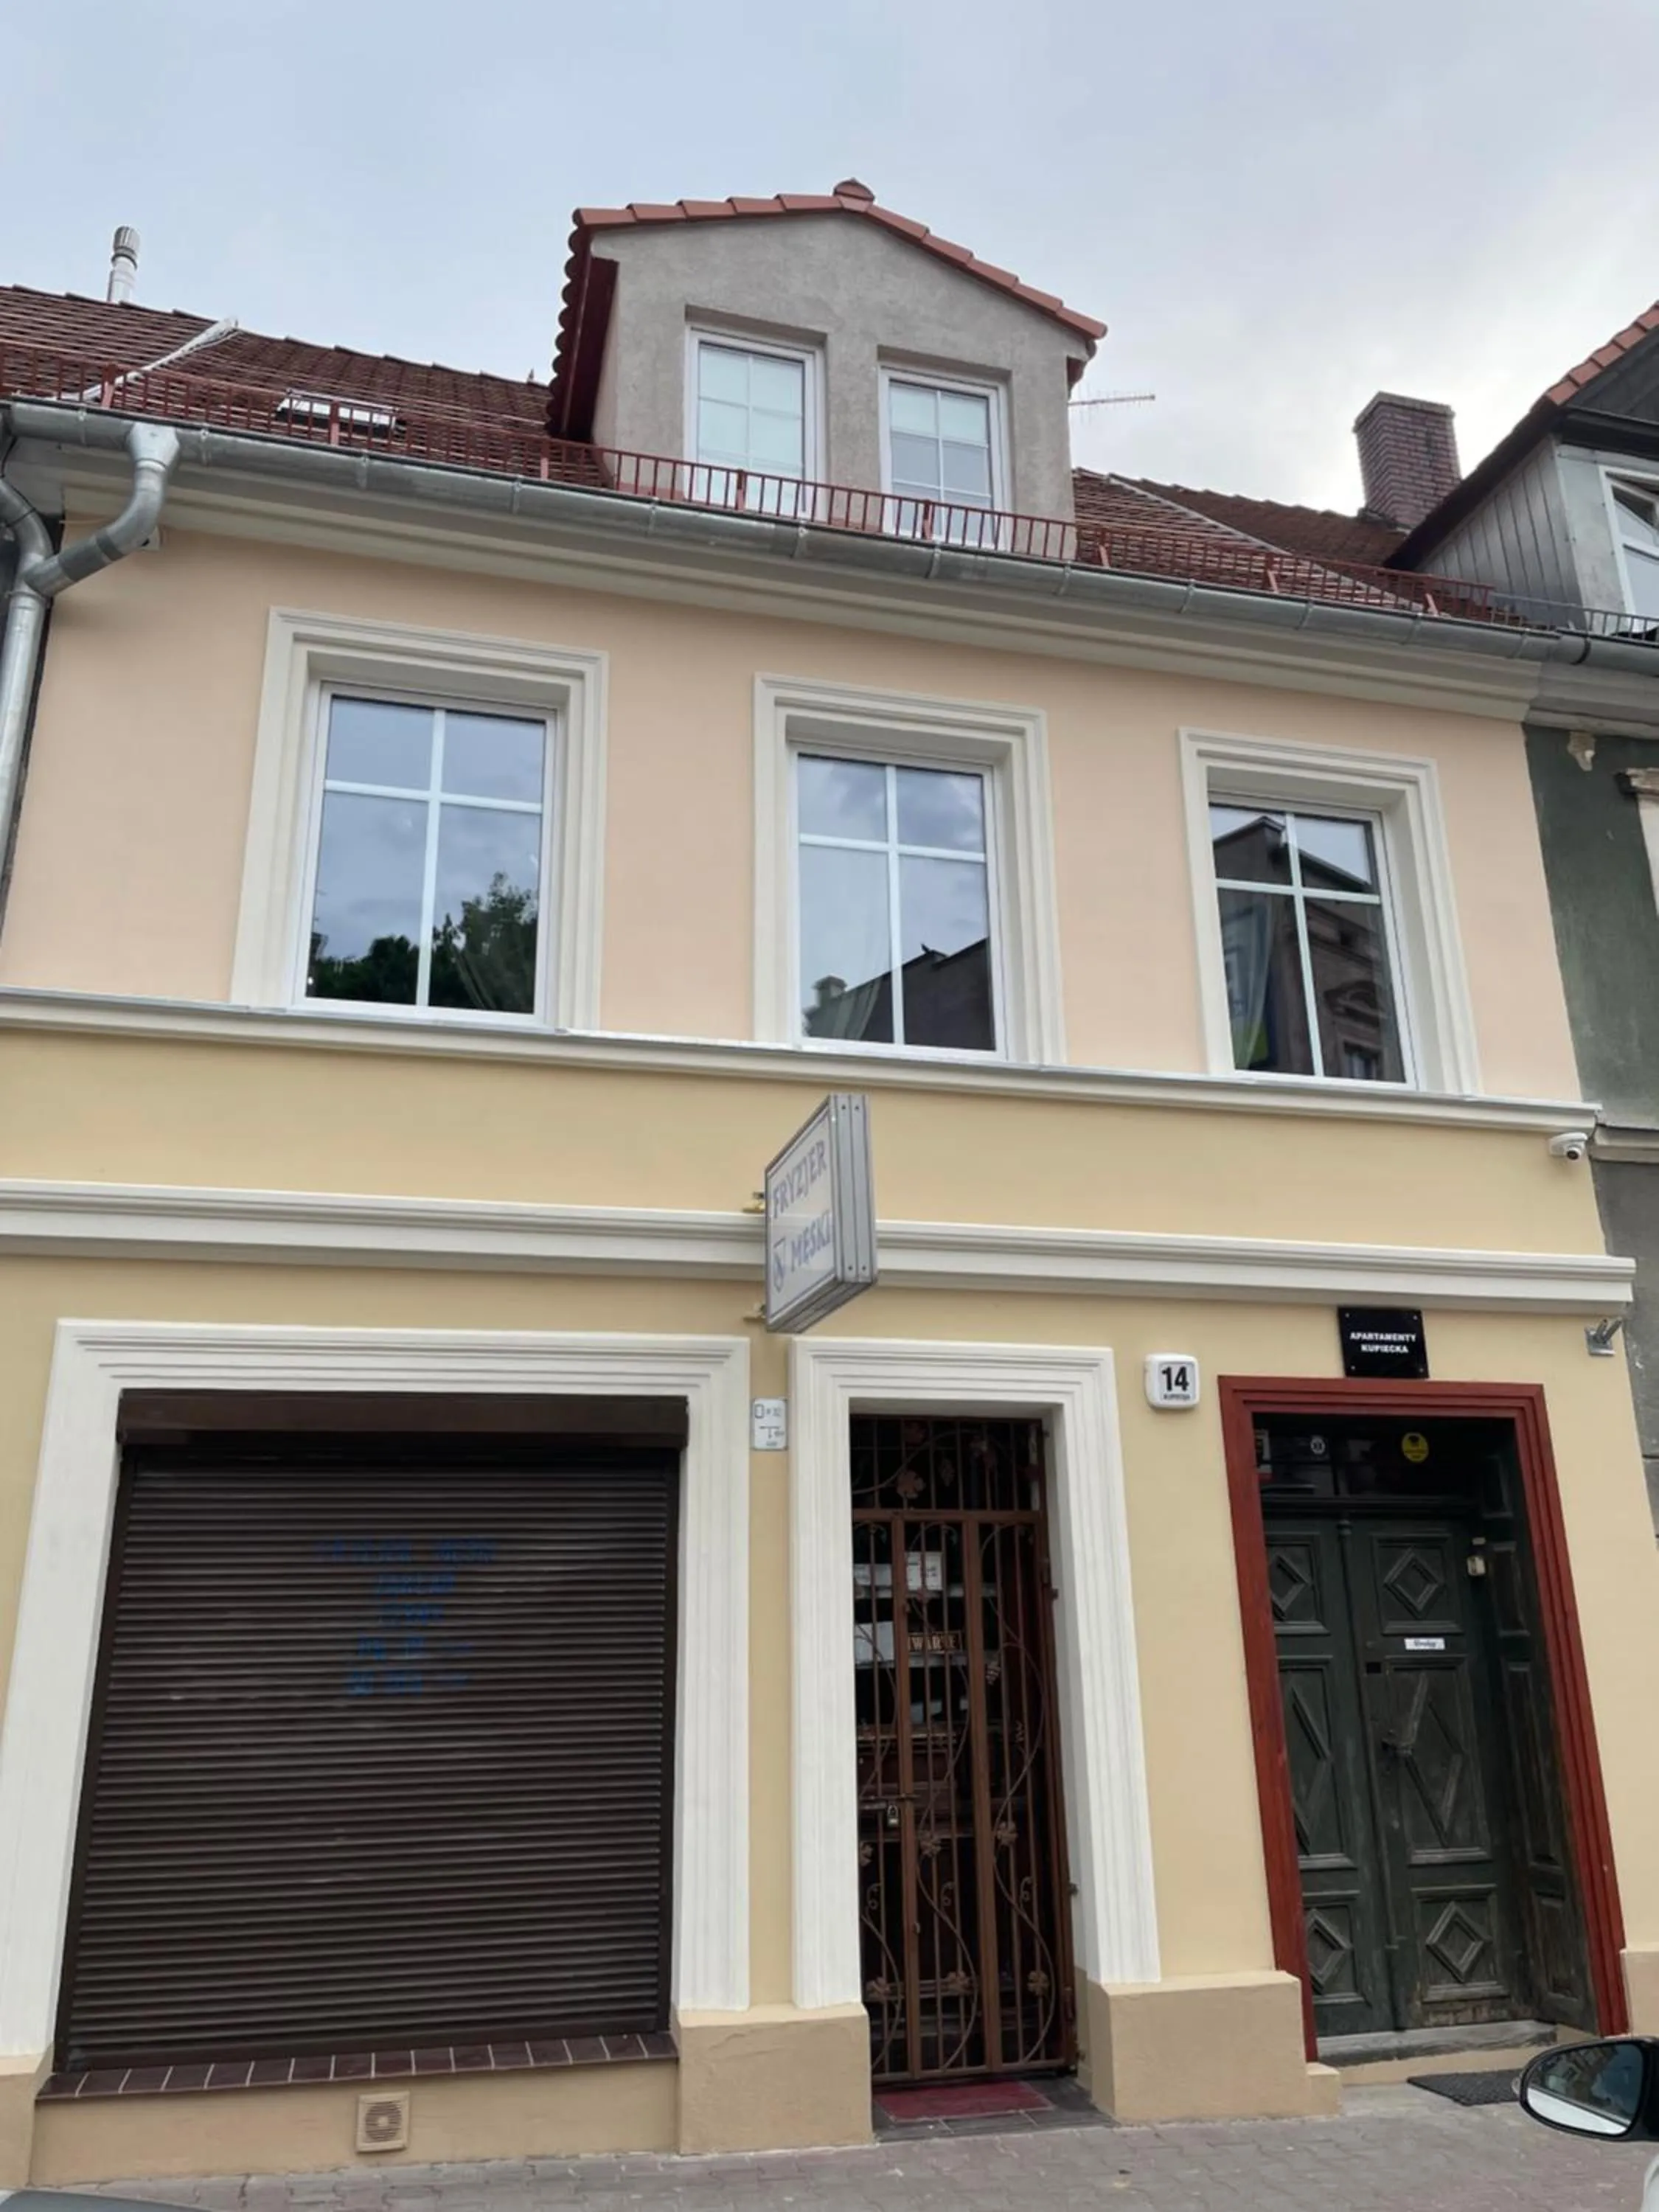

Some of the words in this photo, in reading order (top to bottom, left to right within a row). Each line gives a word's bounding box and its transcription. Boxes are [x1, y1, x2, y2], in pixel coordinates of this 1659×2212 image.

[773, 1140, 827, 1220] FRYZJER
[1349, 1331, 1416, 1342] APARTAMENTY
[1360, 1343, 1409, 1354] KUPIECKA
[1161, 1366, 1189, 1392] 14
